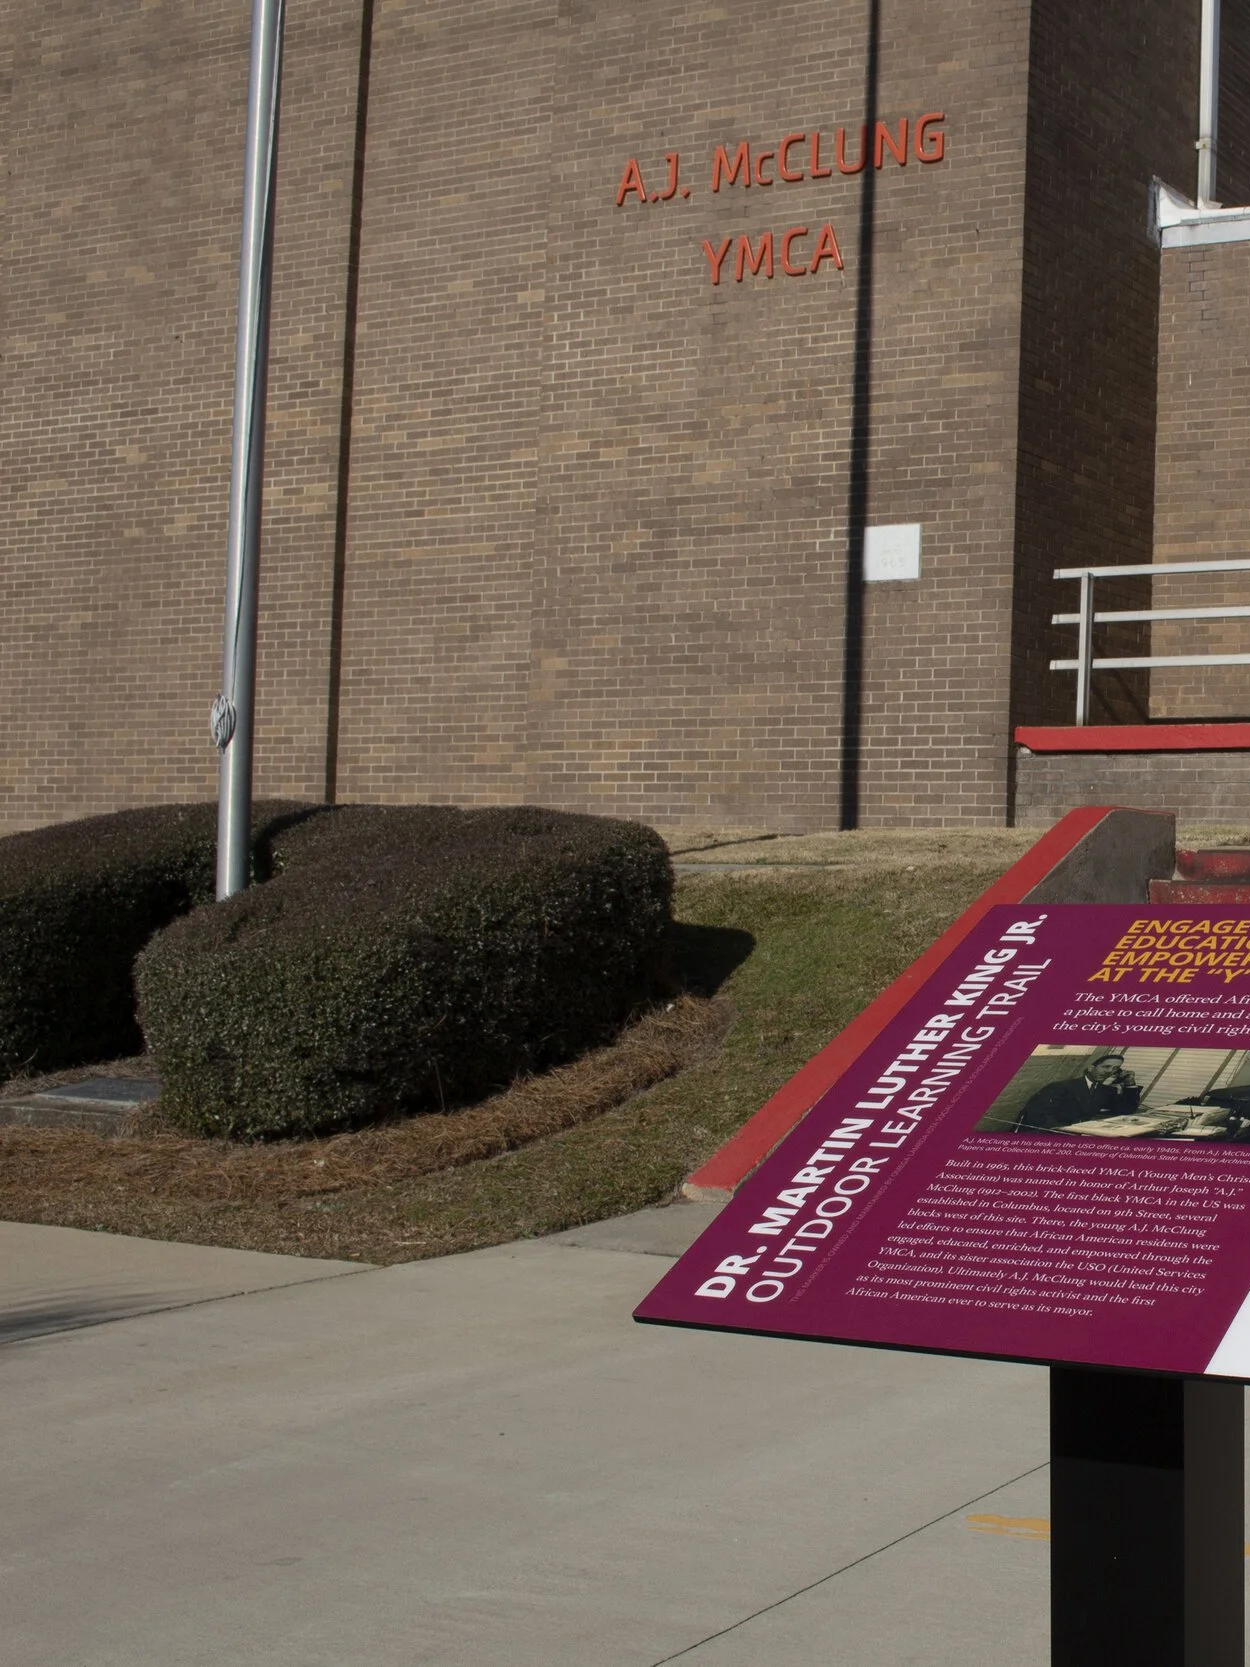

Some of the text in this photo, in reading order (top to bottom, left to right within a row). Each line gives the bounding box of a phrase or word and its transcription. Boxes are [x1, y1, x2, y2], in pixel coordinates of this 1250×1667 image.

[615, 112, 948, 207] A.J. McCLUNG
[702, 223, 845, 286] YMCA
[1087, 967, 1133, 982] AT
[1139, 968, 1199, 983] THE
[1075, 992, 1104, 1001] The
[1109, 993, 1159, 1002] YMCA
[1165, 994, 1223, 1003] offered
[1073, 1007, 1115, 1018] place
[1135, 1008, 1164, 1017] call
[1165, 1008, 1210, 1018] home
[1211, 1009, 1245, 1019] and
[1053, 1021, 1078, 1030] the
[1081, 1022, 1121, 1033] city's
[1121, 1025, 1175, 1035] young
[1178, 1024, 1214, 1033] civil
[695, 913, 1050, 1300] DR. MARTIN LUTHER KING JR.
[746, 958, 1053, 1303] OUTDOOR LEARNING TRAIL
[945, 1159, 971, 1167] Built
[1013, 1163, 1034, 1171] this
[1035, 1164, 1097, 1174] brick-faced
[1099, 1167, 1134, 1177] YMCA
[1138, 1170, 1179, 1181] (Young
[1180, 1172, 1214, 1181] Men's
